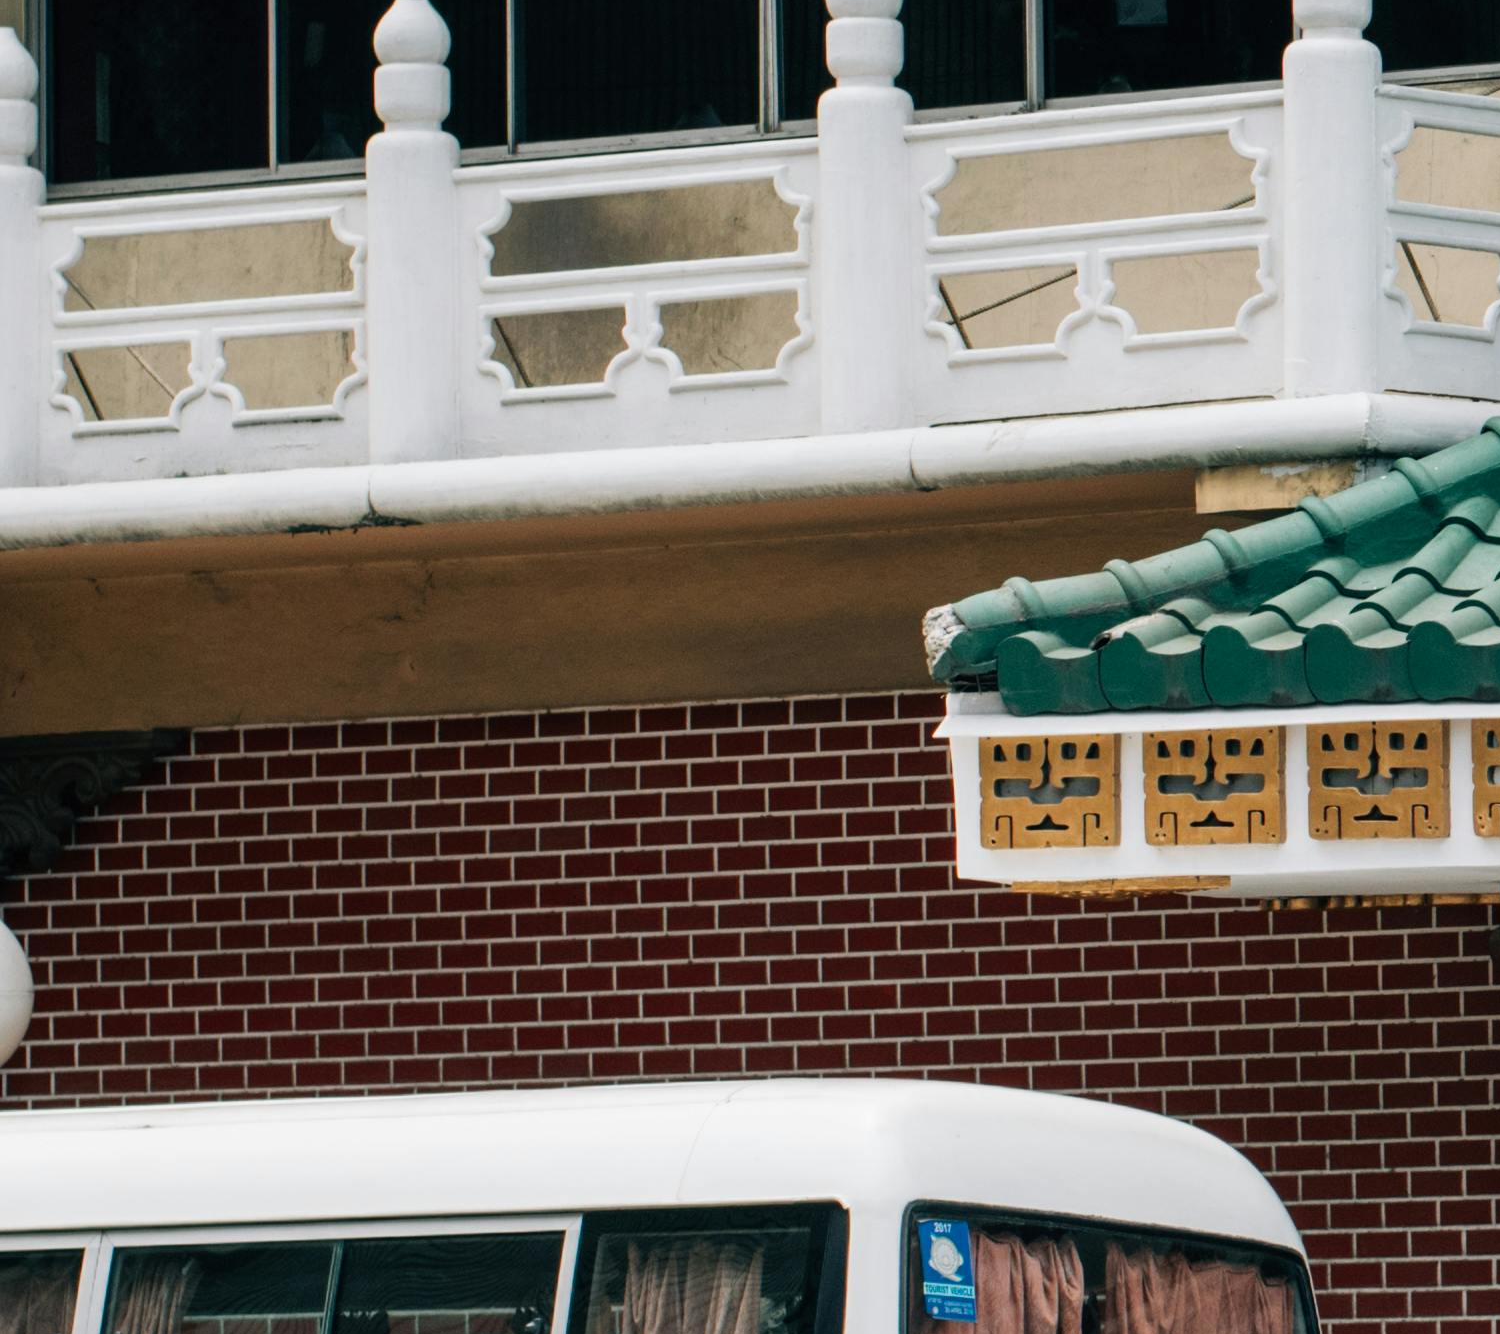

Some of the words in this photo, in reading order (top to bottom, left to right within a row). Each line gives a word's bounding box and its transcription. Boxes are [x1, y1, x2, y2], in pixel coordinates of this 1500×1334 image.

[933, 1221, 952, 1234] 2017
[925, 1284, 949, 1294] TOURIST
[950, 1285, 973, 1296] VEHICLE
